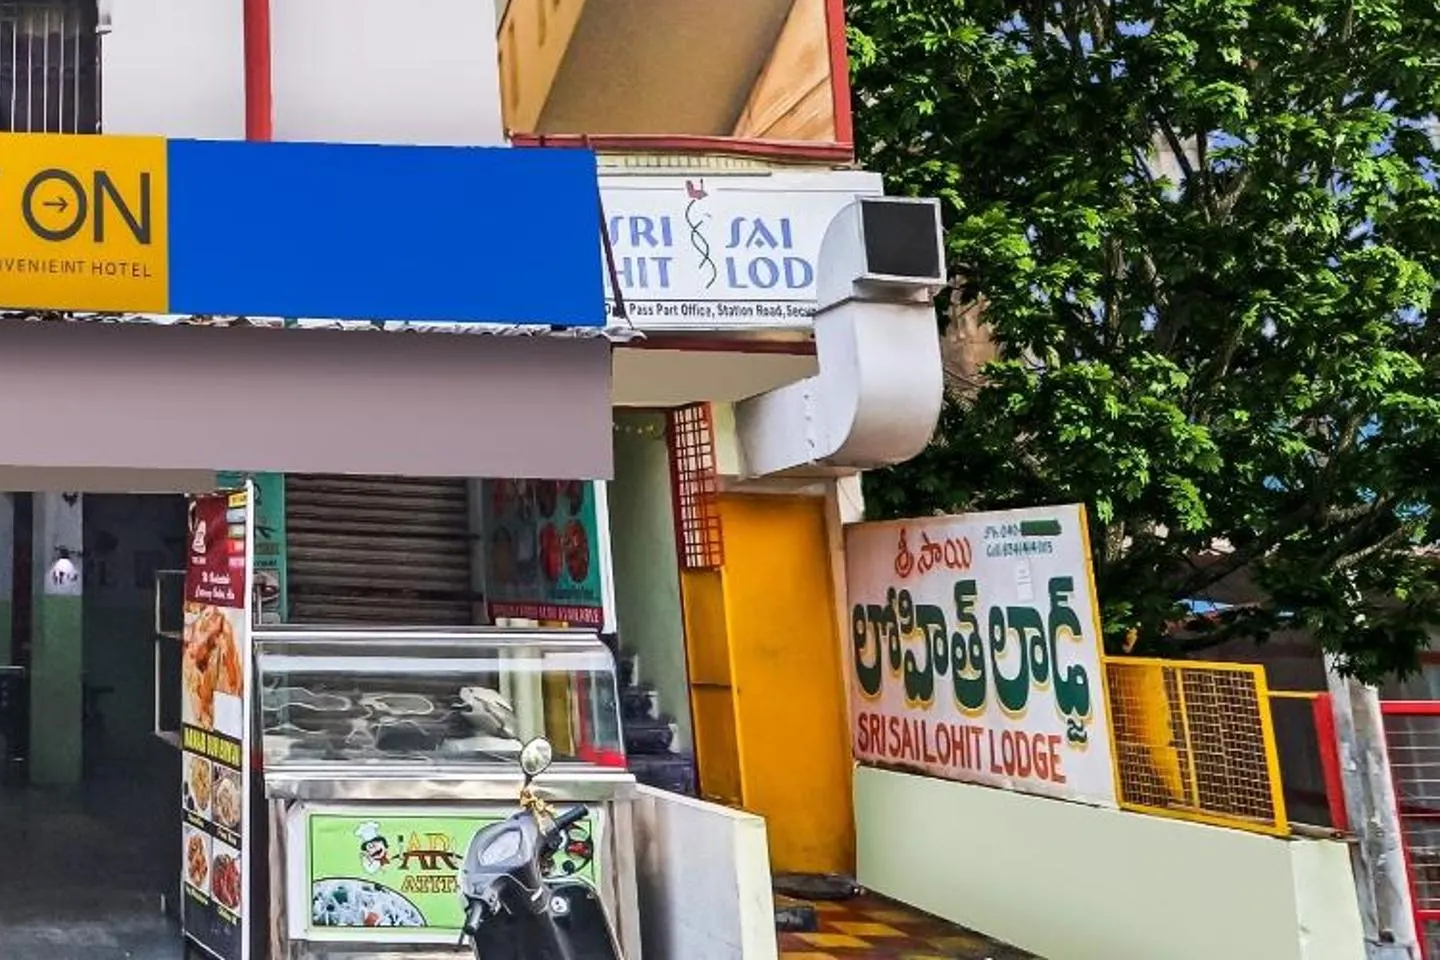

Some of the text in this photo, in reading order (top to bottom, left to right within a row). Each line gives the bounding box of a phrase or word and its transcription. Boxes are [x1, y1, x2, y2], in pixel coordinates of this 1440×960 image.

[21, 168, 151, 245] ON
[725, 216, 793, 249] SAI
[91, 259, 152, 279] HOTEL
[629, 303, 654, 316] Pass
[656, 303, 678, 316] Part
[681, 303, 715, 318] Office,
[717, 304, 753, 317] Station
[988, 730, 1066, 785] LODGE
